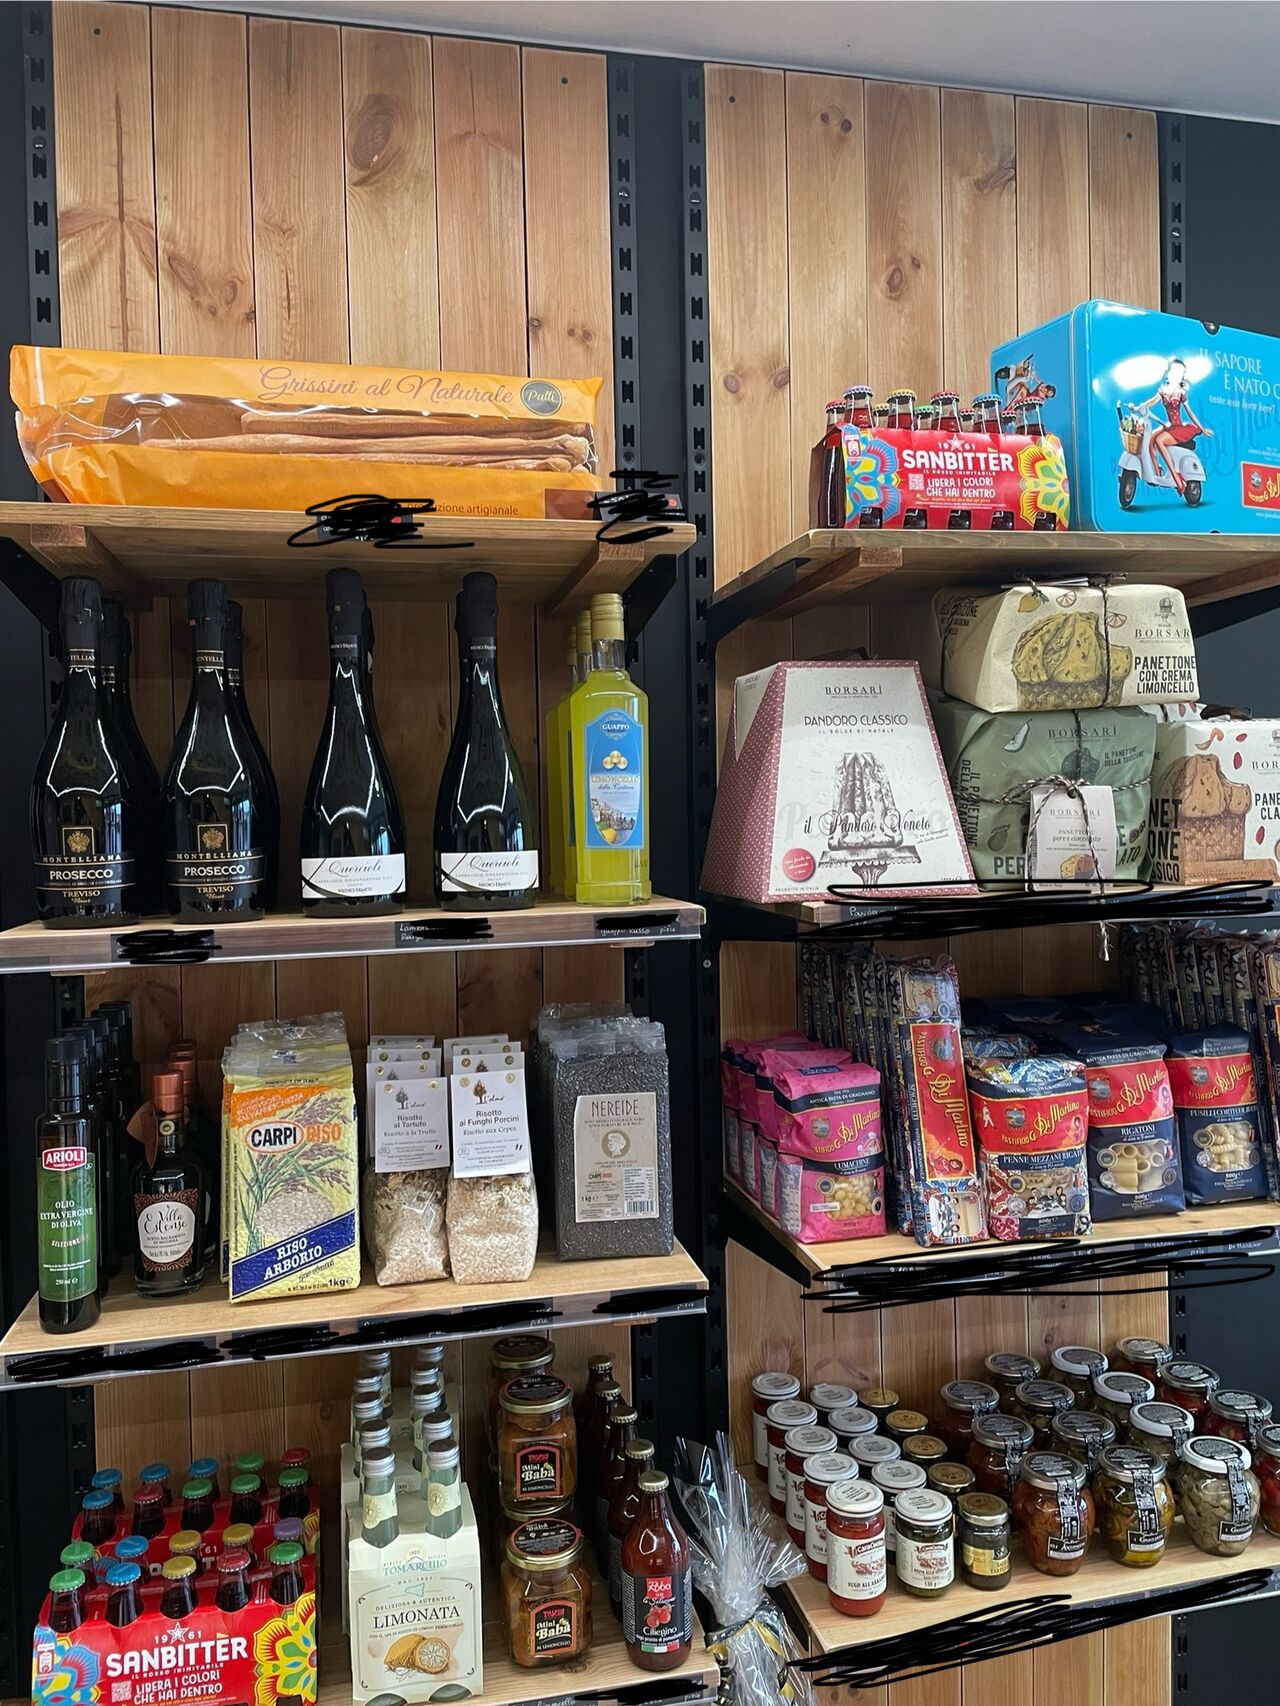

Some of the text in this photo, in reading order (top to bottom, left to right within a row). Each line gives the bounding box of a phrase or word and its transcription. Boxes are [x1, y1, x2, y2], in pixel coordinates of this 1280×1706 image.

[1215, 350, 1263, 375] SAPORE
[257, 366, 514, 404] Grissini al Naturale
[1235, 377, 1271, 397] NATO
[1209, 394, 1226, 405] taste
[902, 448, 1015, 472] SANBITTÈR
[927, 477, 993, 488] LIBERA I COLORI
[926, 487, 996, 499] CHE HAI DENTRO
[467, 504, 519, 516] artigianale
[1135, 628, 1191, 638] BORSAR
[1134, 656, 1195, 670] PANETTONE
[1139, 670, 1192, 682] CON CREMA
[1137, 682, 1195, 694] LIMONCELLO
[804, 715, 909, 726] PANDORO CLASSICO
[602, 723, 629, 731] GUAPPO
[1104, 751, 1110, 760] IL
[1104, 759, 1121, 767] DELLA
[959, 759, 972, 791] DELLA
[966, 772, 981, 848] IL PANETTONE
[1050, 808, 1101, 816] BORSRÌ
[803, 816, 813, 835] il
[818, 810, 877, 836] Pandoro
[885, 809, 931, 831] Veneto
[42, 854, 122, 863] MONTELLIANA
[176, 851, 253, 860] MONTELLIANA
[50, 869, 113, 880] PROSECCO
[184, 865, 245, 877] PROSECCO
[62, 890, 101, 898] TREVISO
[196, 886, 234, 894] TREVISO
[1215, 1072, 1229, 1093] Di
[917, 1031, 967, 1148] PASTIFICIO Di Martino
[827, 1094, 840, 1102] PASTA
[848, 1090, 876, 1099] GRAGNANO
[1090, 1108, 1117, 1119] ASTIFICIO
[1121, 1081, 1140, 1107] Di
[476, 1110, 502, 1118] Risotto
[592, 1099, 639, 1117] NEREIDE
[402, 1120, 427, 1128] Tartufo
[467, 1117, 492, 1127] Funghi
[494, 1115, 519, 1123] Porcini
[1001, 1100, 1080, 1146] PASTIFICIO Di Martino
[251, 1123, 342, 1148] CARPI RISO
[838, 1122, 855, 1145] Di
[1121, 1123, 1156, 1136] RIGATONI
[46, 1150, 84, 1164] ARIOLI
[1003, 1152, 1061, 1164] PENNE MEZZANI
[834, 1158, 870, 1170] LUMACHINE
[55, 1200, 75, 1209] OLIO
[40, 1208, 93, 1220] EXTRA VERGINE
[159, 1204, 183, 1221] Villa
[60, 1220, 82, 1228] OLIVA
[144, 1213, 187, 1234] Estense
[51, 1238, 80, 1248] SELEZIONE
[276, 1237, 308, 1260] RISO
[264, 1245, 322, 1281] ARBORIO
[329, 1278, 346, 1287] 1kg
[522, 1463, 540, 1472] Mini
[205, 1545, 217, 1554] 61
[383, 1558, 448, 1576] TOMARCHIO
[375, 1601, 410, 1611] DELIZIOSA
[419, 1595, 456, 1604] AUTENTICA
[374, 1605, 460, 1629] LIMONATA
[536, 1619, 556, 1630] Mini
[154, 1631, 202, 1644] 19 61
[643, 1626, 678, 1637] Ciliegino
[542, 1640, 571, 1650] LIMONCELLO
[106, 1632, 249, 1678] SANBITTÈR
[143, 1670, 170, 1678] ROSSO
[173, 1662, 224, 1674] INIMITABILE
[136, 1670, 220, 1694] LIBERA I COLORI
[134, 1693, 155, 1705] CHE
[158, 1690, 177, 1702] HAI
[180, 1683, 223, 1698] DENTRO
